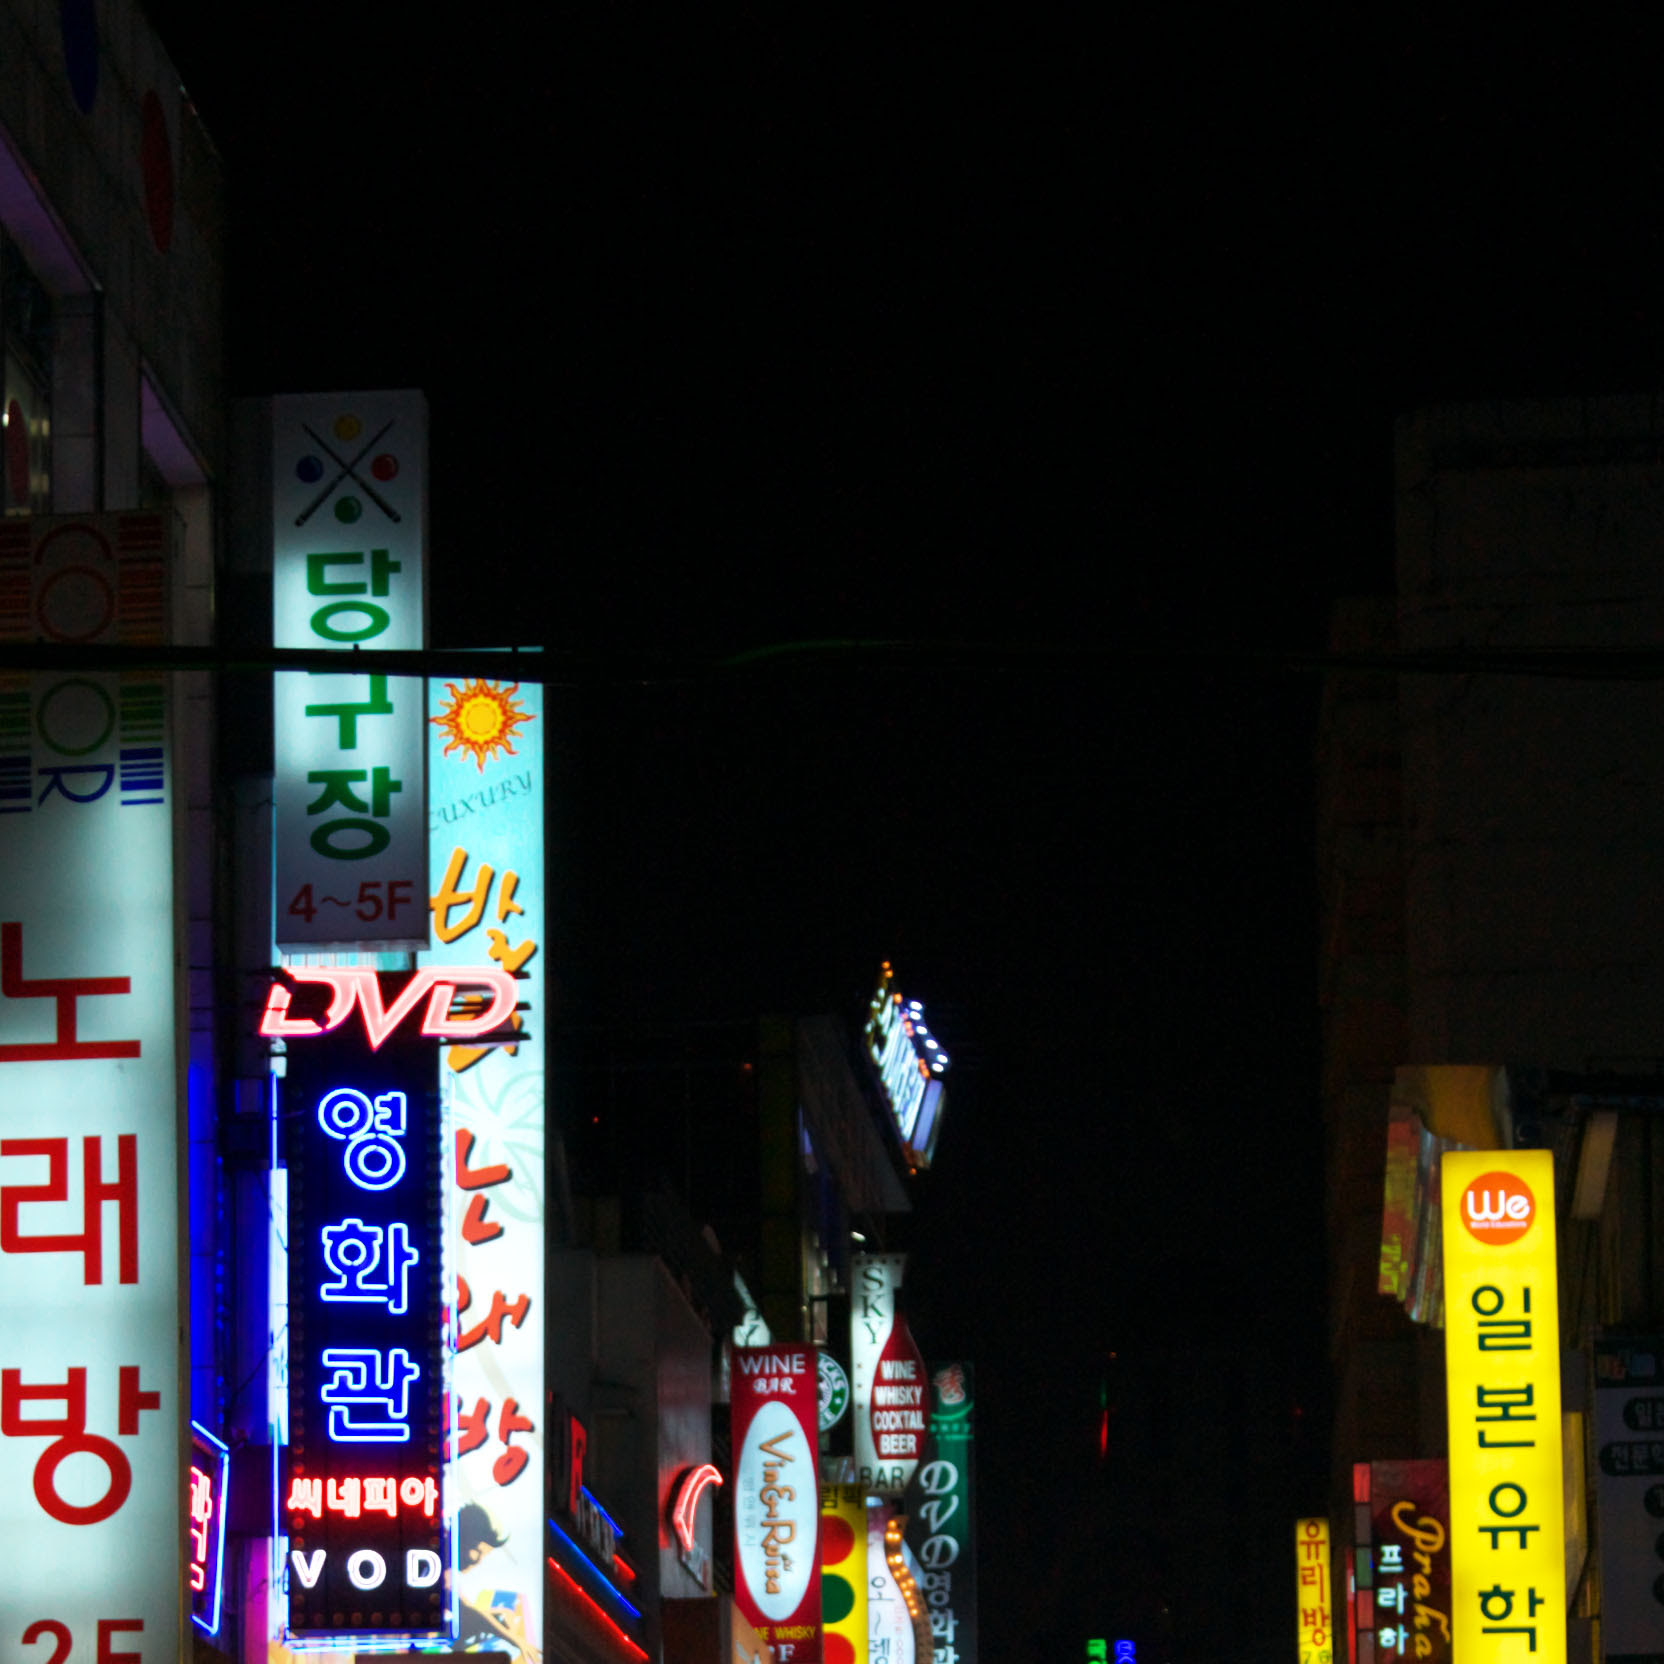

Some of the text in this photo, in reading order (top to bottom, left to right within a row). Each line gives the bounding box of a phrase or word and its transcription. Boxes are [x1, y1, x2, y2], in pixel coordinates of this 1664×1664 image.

[303, 547, 403, 863] 당구장
[288, 879, 415, 923] 4~5F
[258, 965, 520, 1052] DVD
[1467, 1189, 1531, 1221] We
[318, 1087, 419, 1444] 영화관
[860, 1265, 888, 1347] SKY
[740, 1353, 806, 1376] WINE
[875, 1385, 923, 1406] WHISKY
[880, 1359, 918, 1381] WINE
[874, 1410, 927, 1431] COCKTAIL
[880, 1434, 918, 1454] BEER
[287, 1475, 439, 1520] 씨네피아
[860, 1465, 907, 1489] BAR
[1471, 1284, 1544, 1654] 일본유학
[918, 1459, 961, 1568] DVD
[1299, 1520, 1331, 1650] 유리방
[1378, 1544, 1405, 1656] 프라하
[1389, 1500, 1451, 1662] Praha
